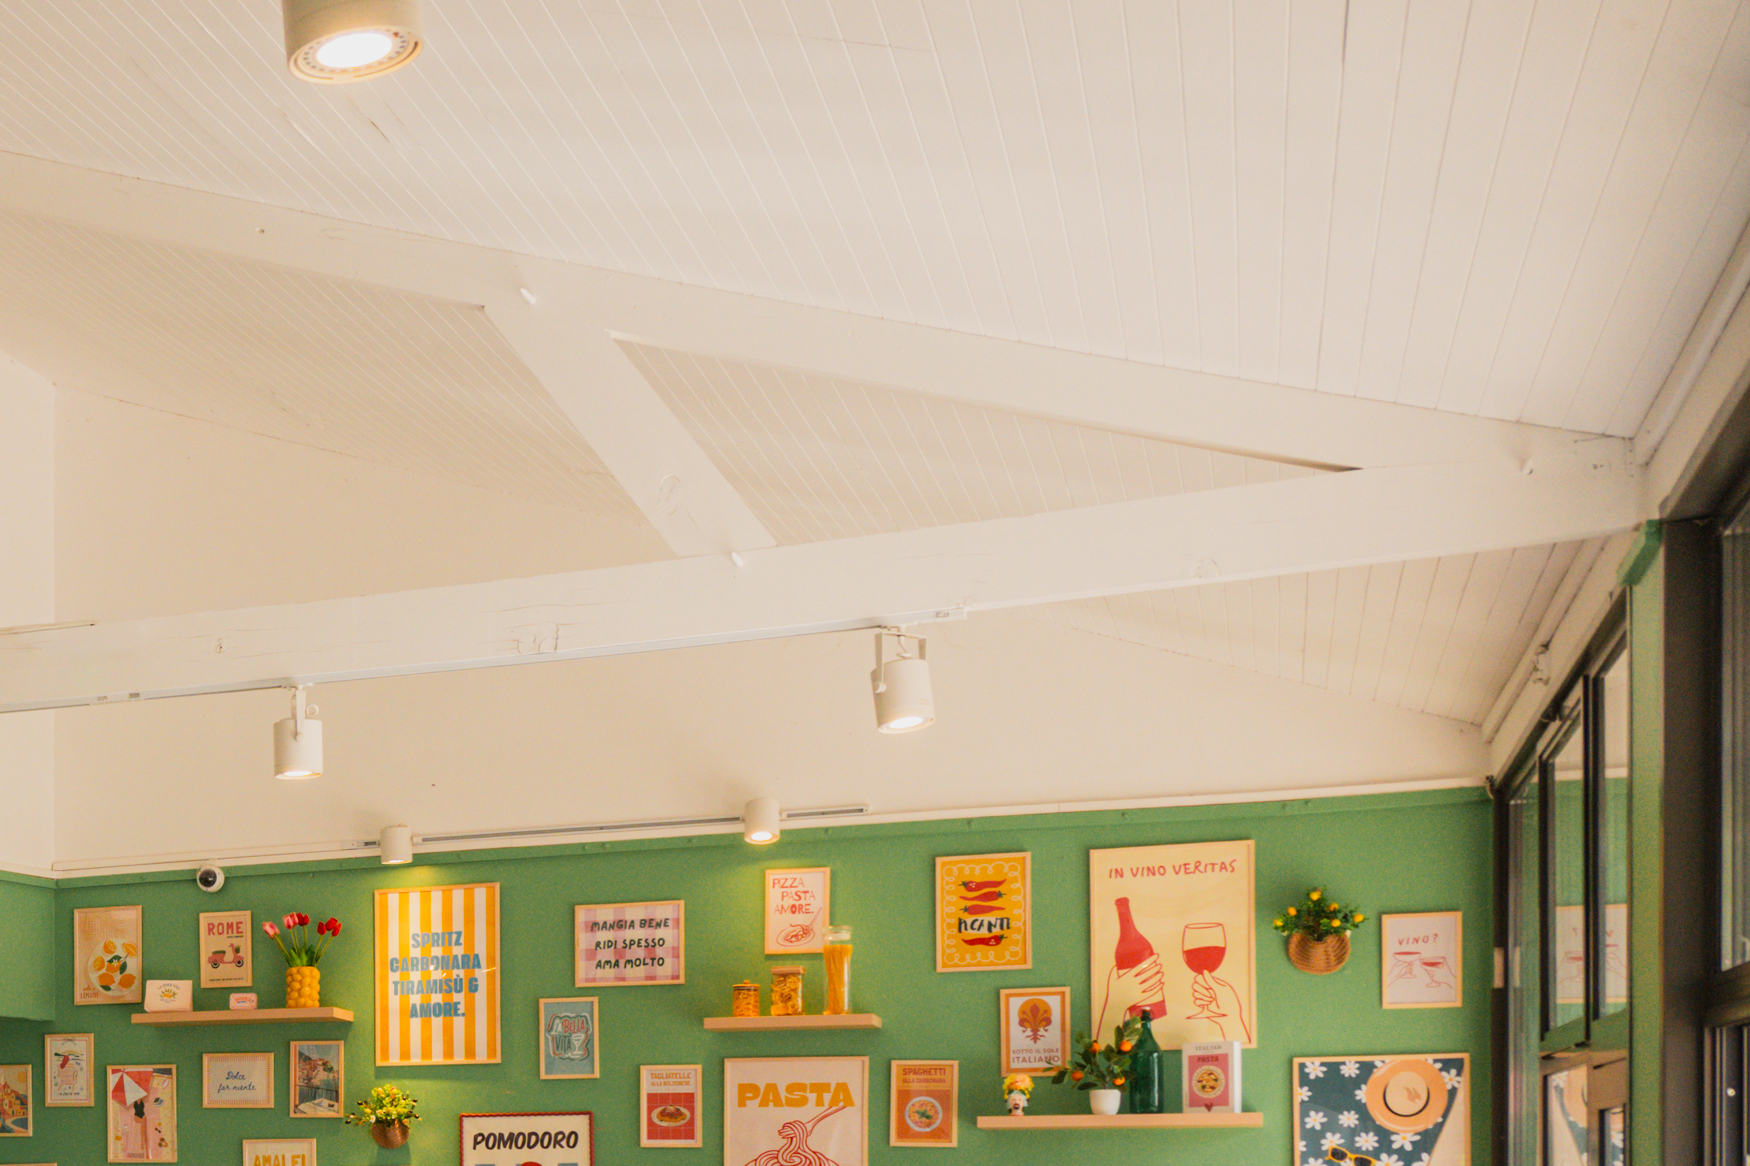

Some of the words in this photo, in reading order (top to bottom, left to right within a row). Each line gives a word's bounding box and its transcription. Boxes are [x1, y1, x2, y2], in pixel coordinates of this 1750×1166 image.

[1109, 867, 1124, 879] IN
[1130, 865, 1167, 878] VINO
[1172, 859, 1237, 875] VERITAS
[772, 877, 805, 889] PIZZA
[781, 890, 816, 902] PASTA
[773, 903, 814, 915] AMORE.
[207, 921, 244, 936] ROME
[590, 919, 635, 932] MANGIA
[639, 918, 670, 929] BENE
[411, 931, 463, 949] SPRITZ
[595, 940, 617, 951] RIDI
[622, 938, 665, 949] SPESSO
[389, 953, 482, 973] CARBONARA
[595, 959, 620, 970] AMA
[624, 957, 665, 969] MOLTO
[393, 974, 464, 996] TIRAMISÙ
[409, 1001, 466, 1019] AMORE.
[1012, 1055, 1061, 1064] ITALIANO
[226, 1071, 246, 1080] Dolce
[650, 1072, 691, 1080] TAGLIATELLE
[902, 1067, 947, 1076] SPAGHETTI
[217, 1083, 230, 1093] far
[233, 1082, 257, 1091] niente
[737, 1082, 856, 1108] PASTA
[472, 1130, 579, 1151] POMODORO
